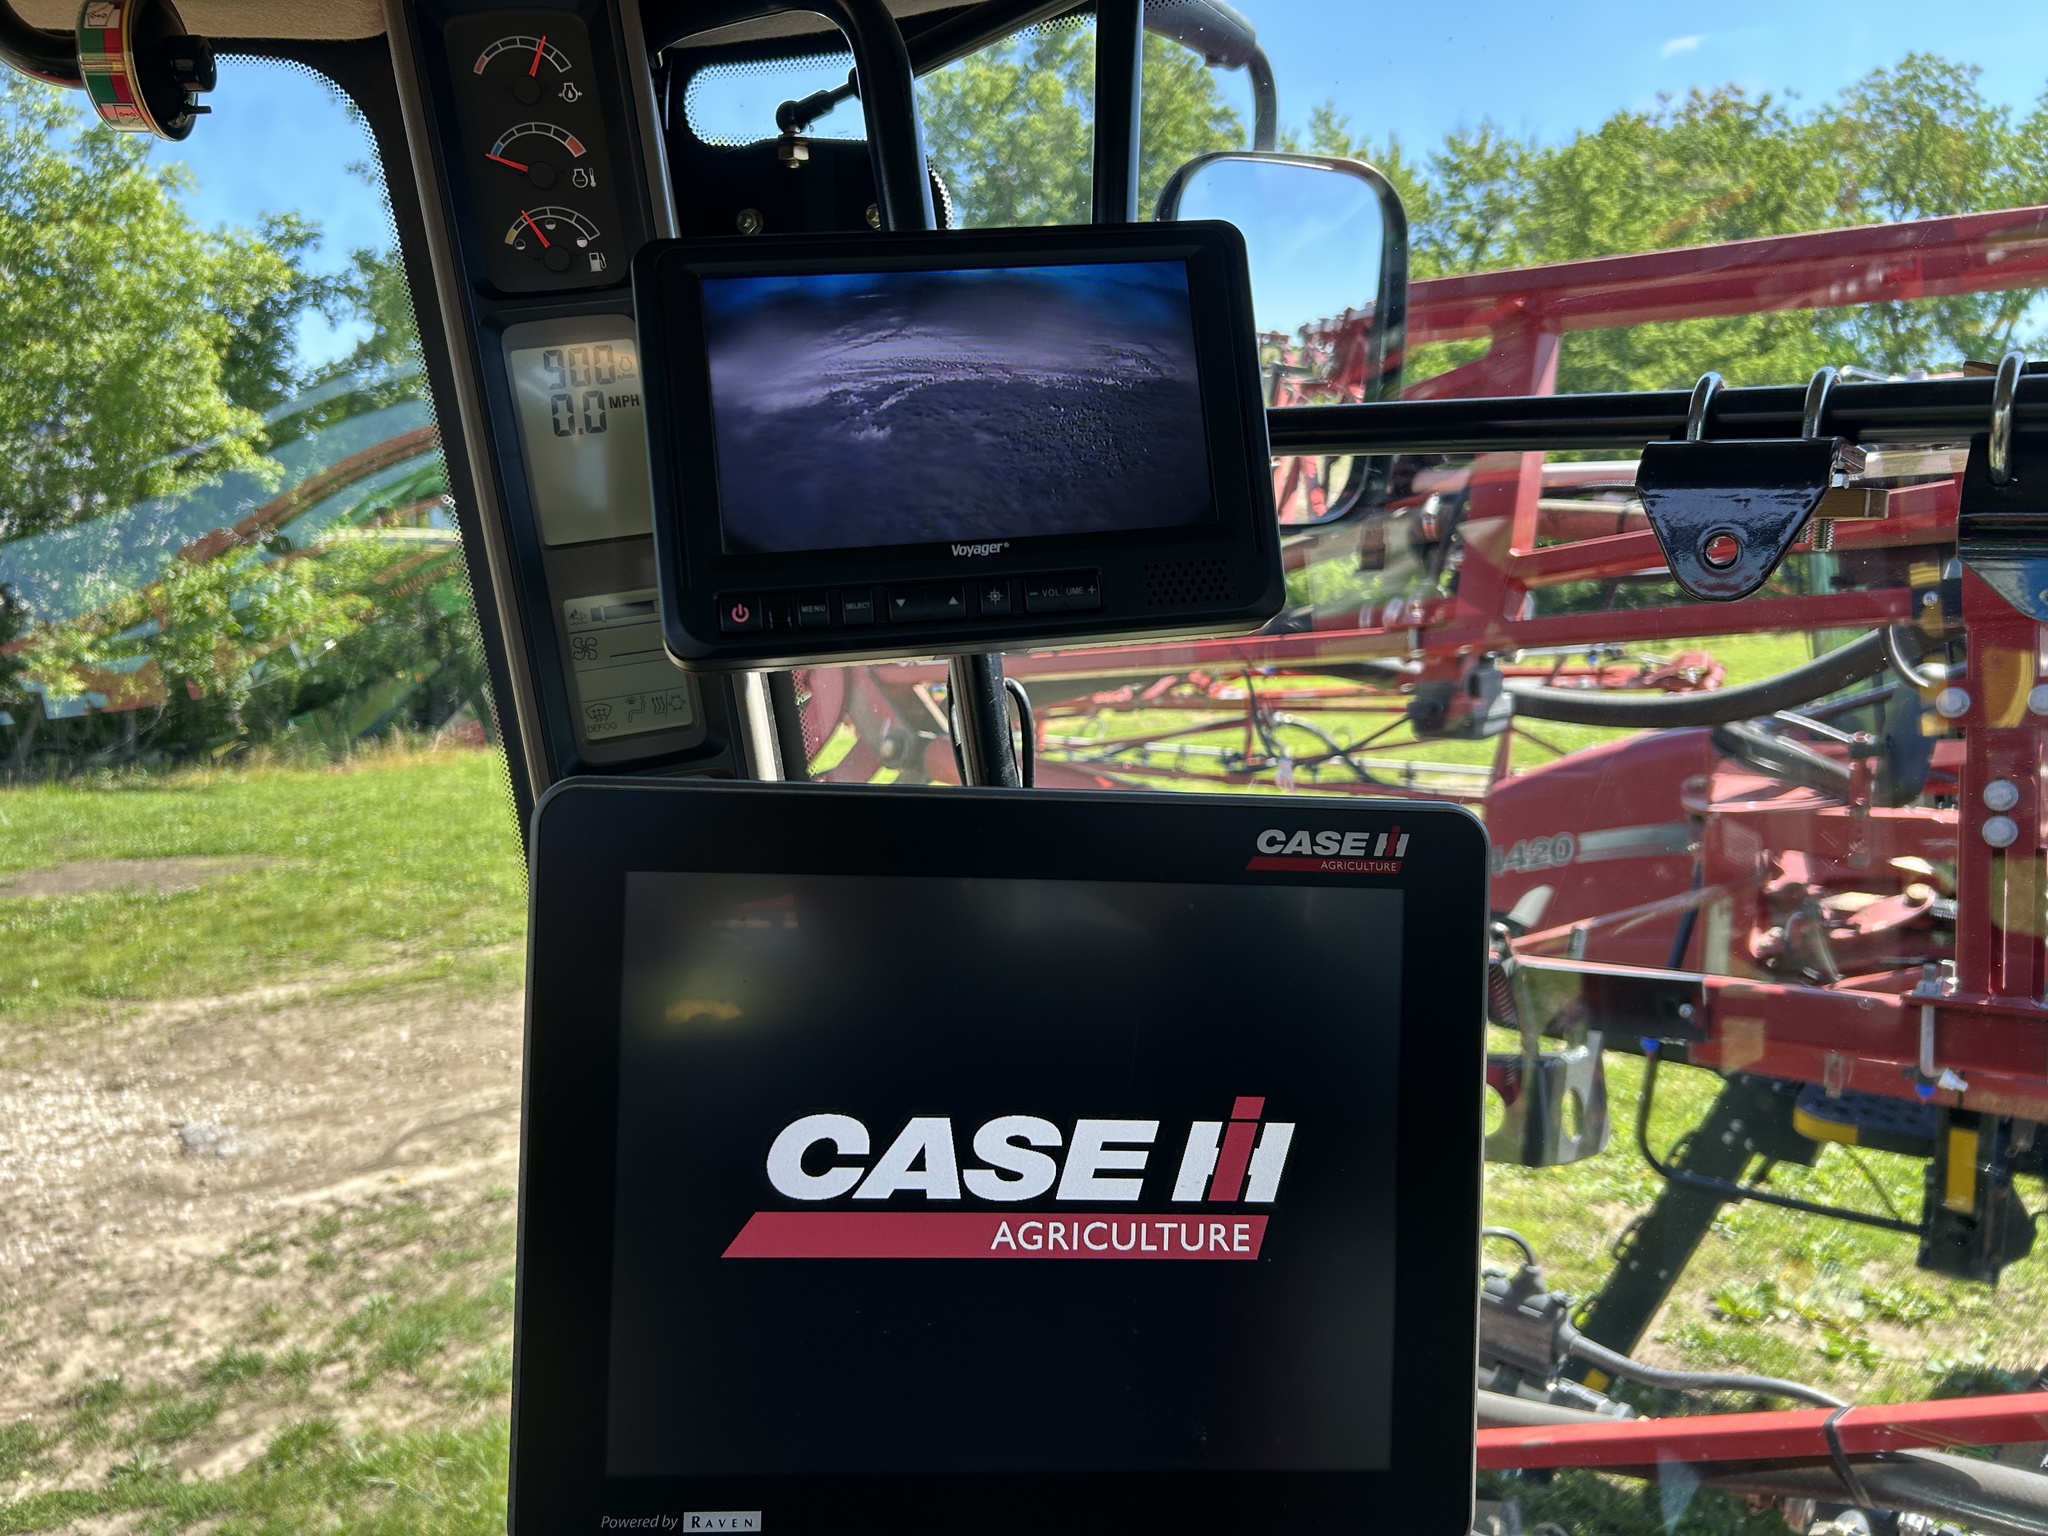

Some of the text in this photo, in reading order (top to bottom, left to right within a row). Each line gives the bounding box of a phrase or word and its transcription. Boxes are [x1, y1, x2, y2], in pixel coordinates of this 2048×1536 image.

[543, 344, 616, 390] 900
[551, 390, 640, 437] 0.0 MPH
[801, 604, 826, 614] MENU
[845, 601, 871, 610] SELECT
[587, 722, 617, 733] DEFOG
[1256, 828, 1370, 856] CASE
[1320, 860, 1397, 872] AGRICULTURE
[766, 1113, 1160, 1202] CASE
[990, 1220, 1251, 1252] AGRICULTURE
[601, 1514, 753, 1531] Powered by RAVEN
